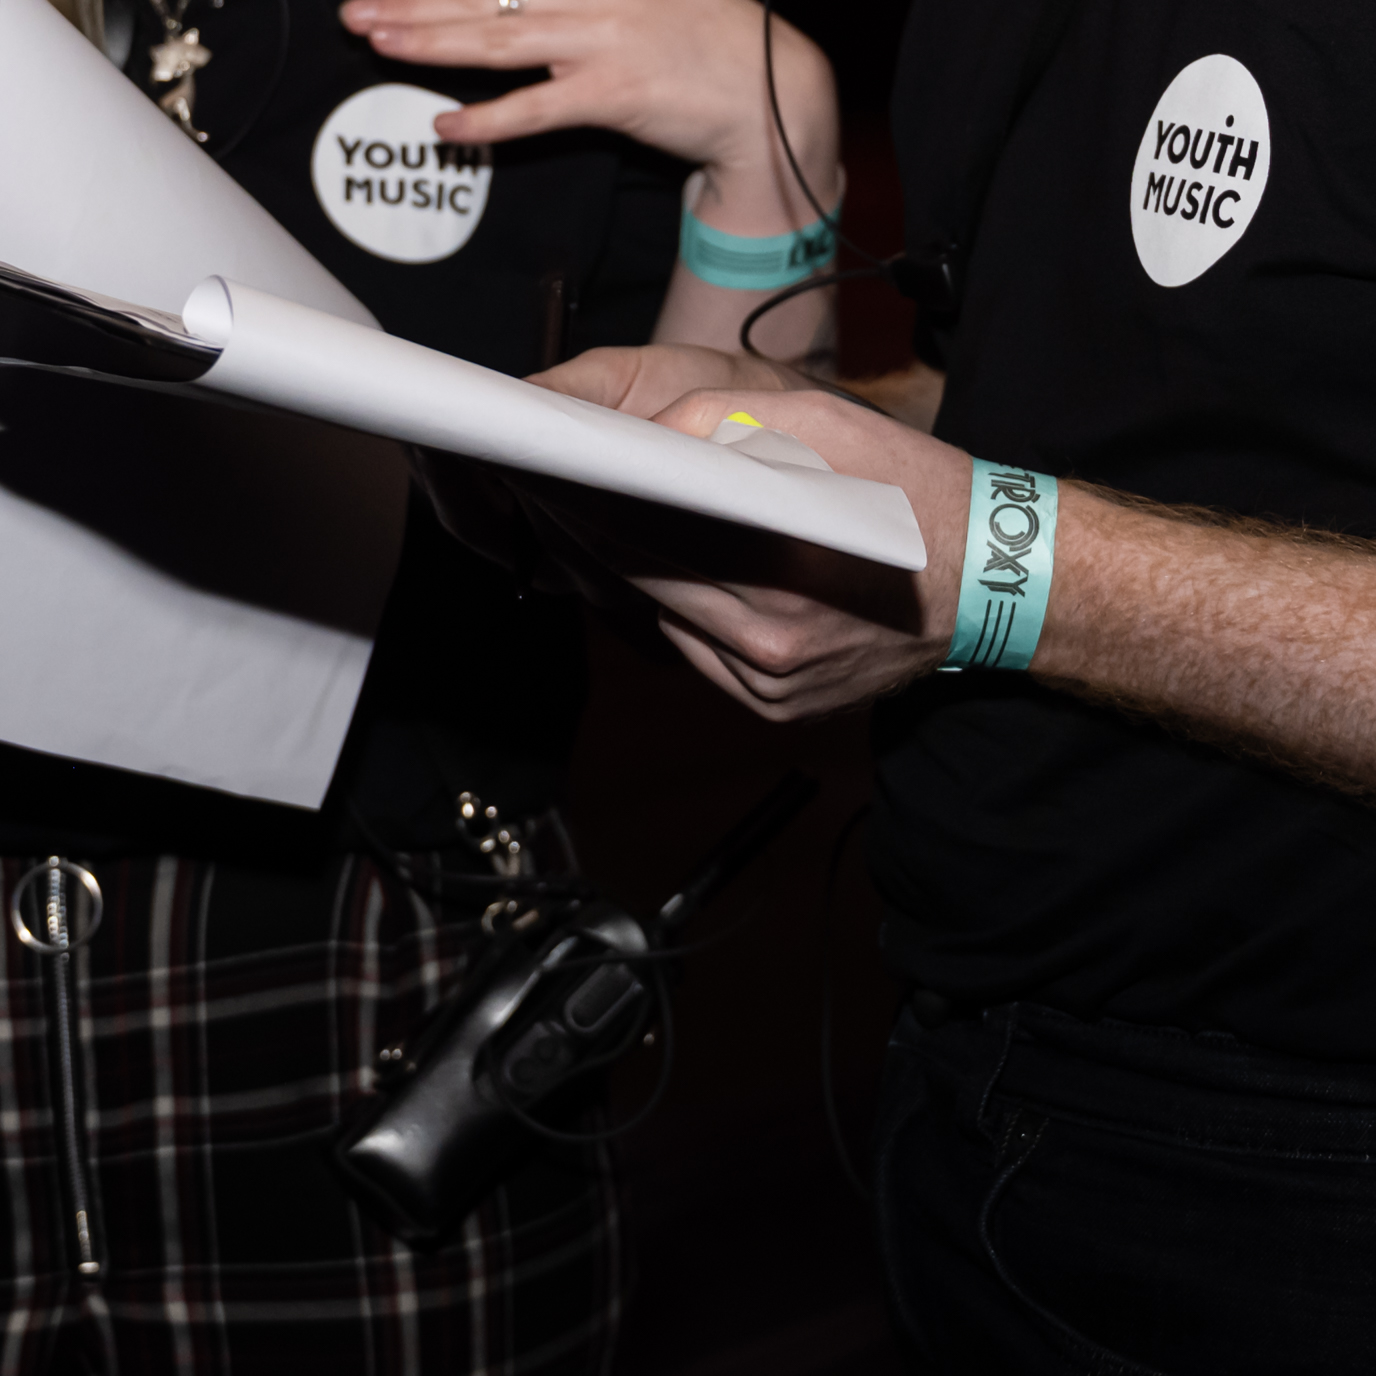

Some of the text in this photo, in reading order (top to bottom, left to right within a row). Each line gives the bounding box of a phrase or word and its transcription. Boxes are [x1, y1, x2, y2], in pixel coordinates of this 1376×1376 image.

[337, 135, 482, 176] YOUTH
[1154, 119, 1259, 181] YOUTH
[345, 176, 473, 215] MUSIC
[1143, 171, 1242, 229] MUSIC
[977, 472, 1041, 598] TROXY
